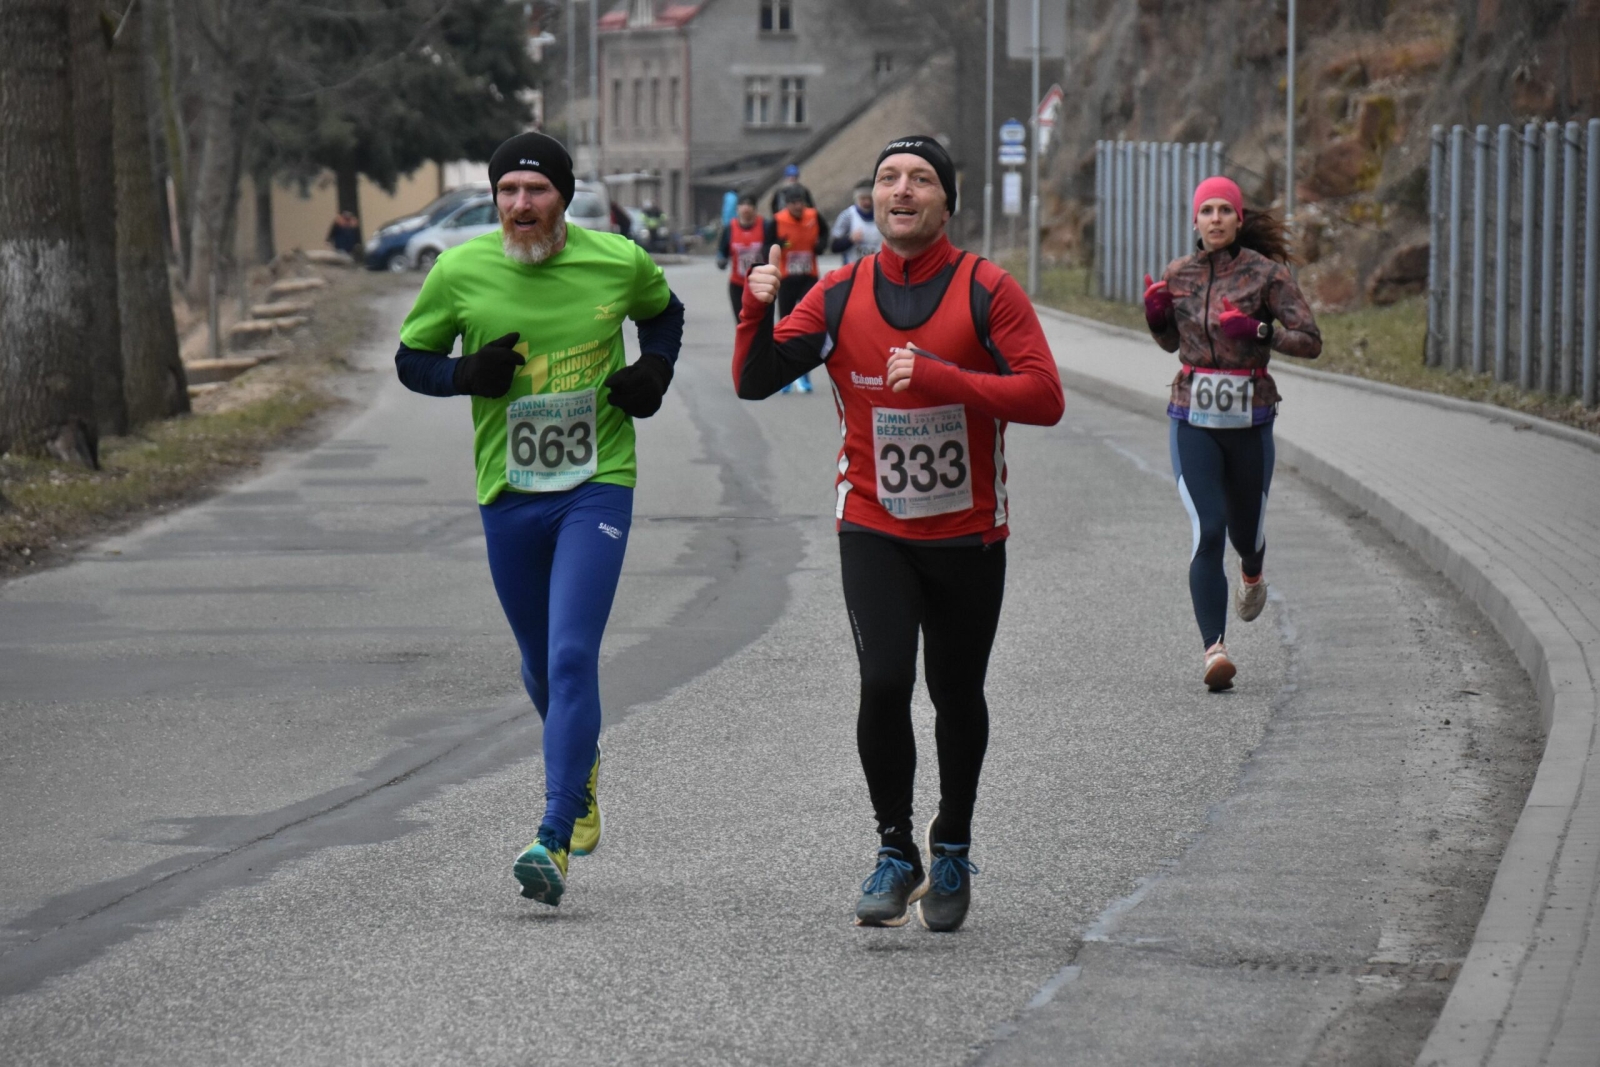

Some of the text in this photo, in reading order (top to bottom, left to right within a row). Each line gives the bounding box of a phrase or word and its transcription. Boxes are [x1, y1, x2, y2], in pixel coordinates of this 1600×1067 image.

[526, 159, 540, 167] JAKO
[567, 340, 599, 356] MIZUNO
[551, 349, 610, 377] RUNNING
[551, 373, 580, 393] CUP
[1196, 376, 1249, 413] 661
[510, 398, 546, 412] ZIMNÍ
[567, 405, 592, 417] LIGA
[877, 412, 911, 424] ZIMNÍ
[876, 424, 930, 436] BĚŽECKÁ
[935, 421, 963, 433] LIGA
[511, 421, 593, 468] 663
[880, 440, 967, 494] 333
